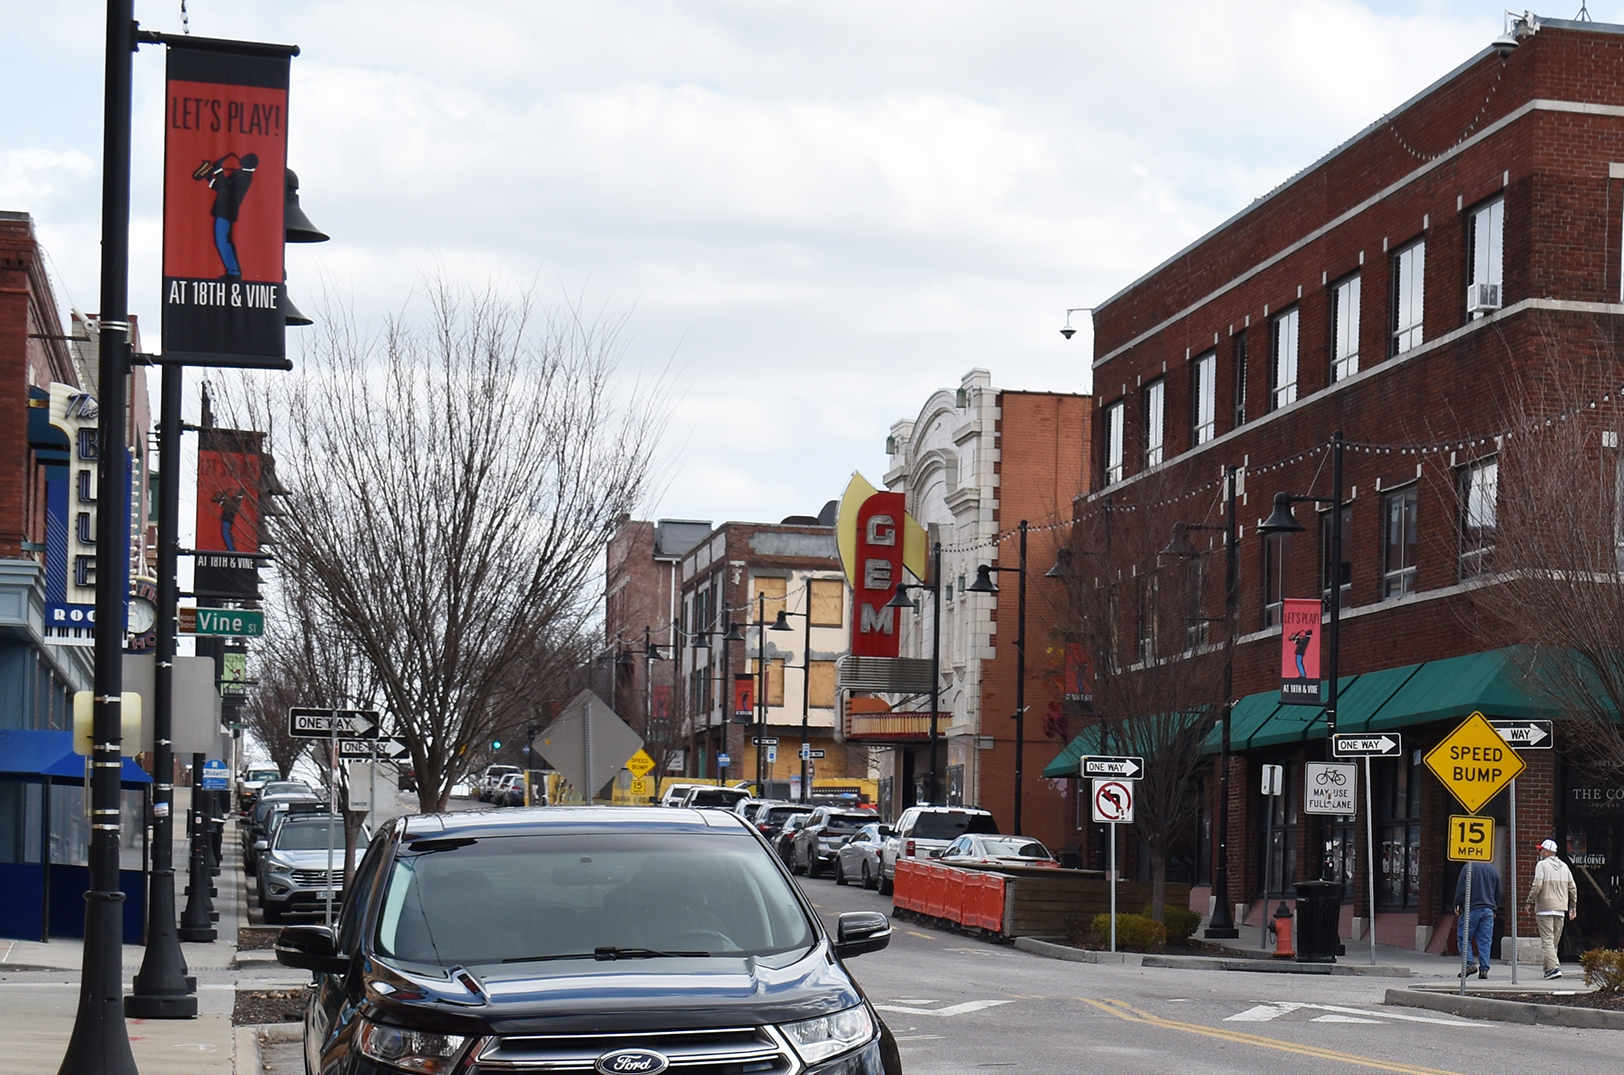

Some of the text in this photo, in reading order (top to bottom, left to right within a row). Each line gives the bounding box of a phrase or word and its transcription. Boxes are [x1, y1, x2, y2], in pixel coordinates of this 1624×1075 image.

[172, 96, 280, 137] LET'S PLAY!
[169, 280, 278, 309] AT 18TH & VINE
[860, 514, 896, 636] GEM
[198, 612, 258, 633] Vine ST
[1284, 612, 1320, 625] LET'S PLAY!
[1282, 684, 1290, 693] AT
[298, 717, 323, 729] ONE
[1511, 729, 1531, 740] WAY
[344, 742, 364, 752] ONE
[1340, 741, 1380, 749] ONE WAY
[1450, 746, 1503, 762] SPEED
[1088, 762, 1125, 772] ONE WAY
[1453, 766, 1503, 783] BUMP
[633, 781, 643, 789] 15
[1313, 788, 1348, 797] MAY USE
[1572, 788, 1602, 800] THE
[1332, 801, 1352, 809] LANE
[1458, 822, 1486, 844] 15
[1458, 846, 1483, 857] MPH
[613, 1055, 652, 1070] Ford
